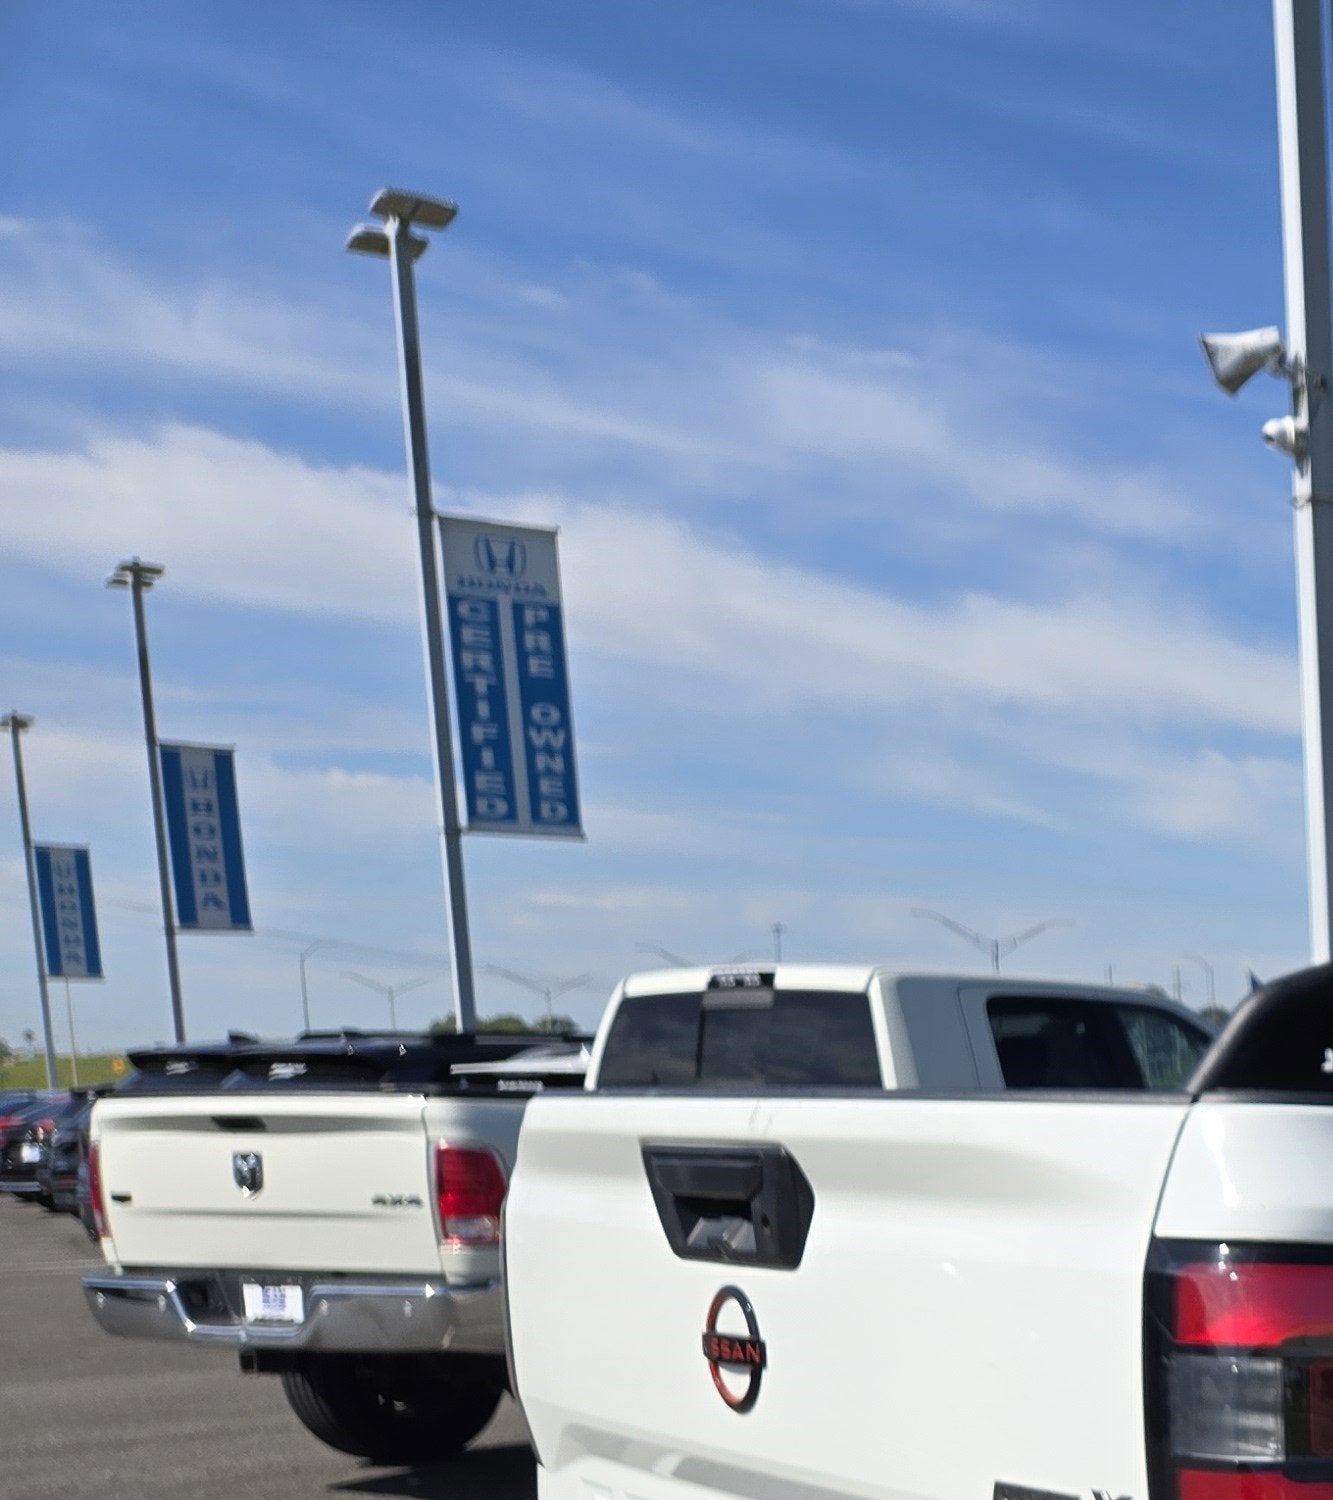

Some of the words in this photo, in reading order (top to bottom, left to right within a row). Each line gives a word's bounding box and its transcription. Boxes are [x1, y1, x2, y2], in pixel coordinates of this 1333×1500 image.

[523, 604, 555, 679] PRE
[457, 600, 509, 819] CERTIFIED
[529, 702, 569, 824] OWNED
